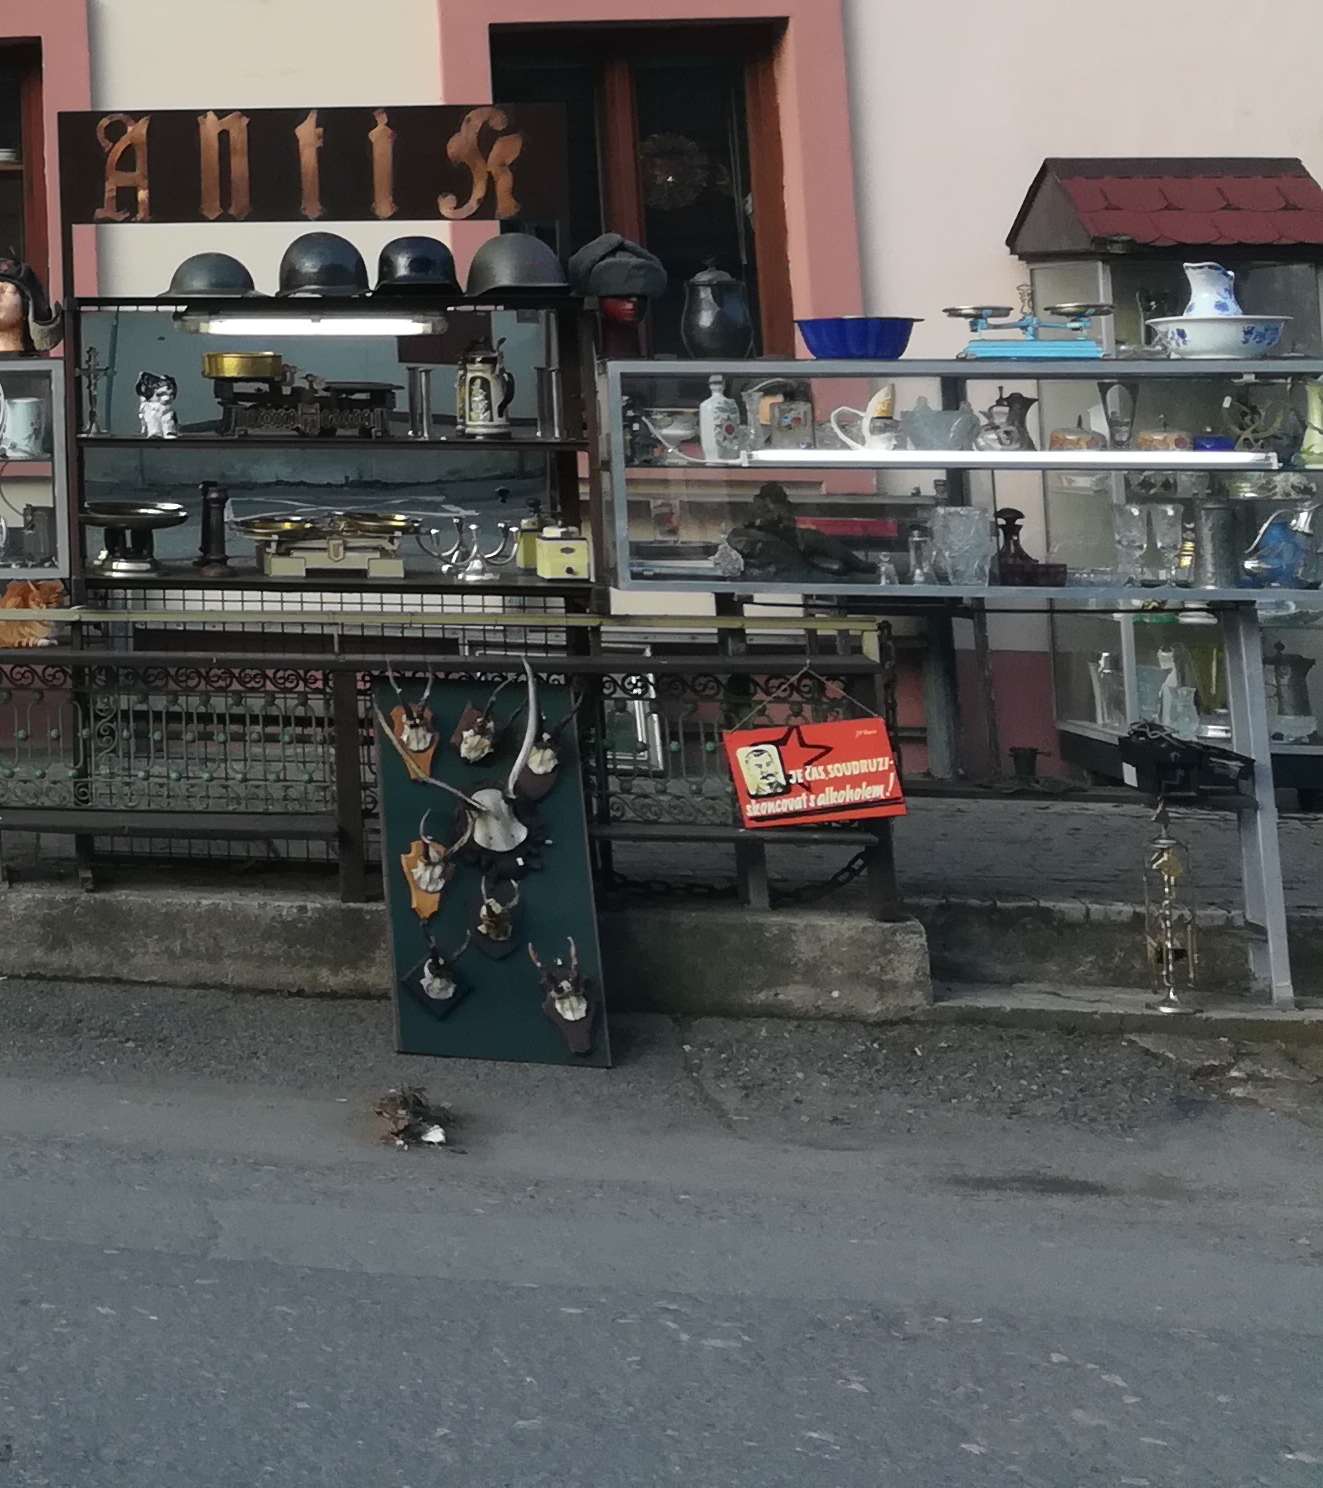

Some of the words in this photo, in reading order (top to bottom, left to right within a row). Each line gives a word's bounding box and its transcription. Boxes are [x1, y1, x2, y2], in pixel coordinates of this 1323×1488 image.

[788, 768, 804, 784] JE
[745, 791, 807, 817] skoncovat
[809, 793, 816, 808] s
